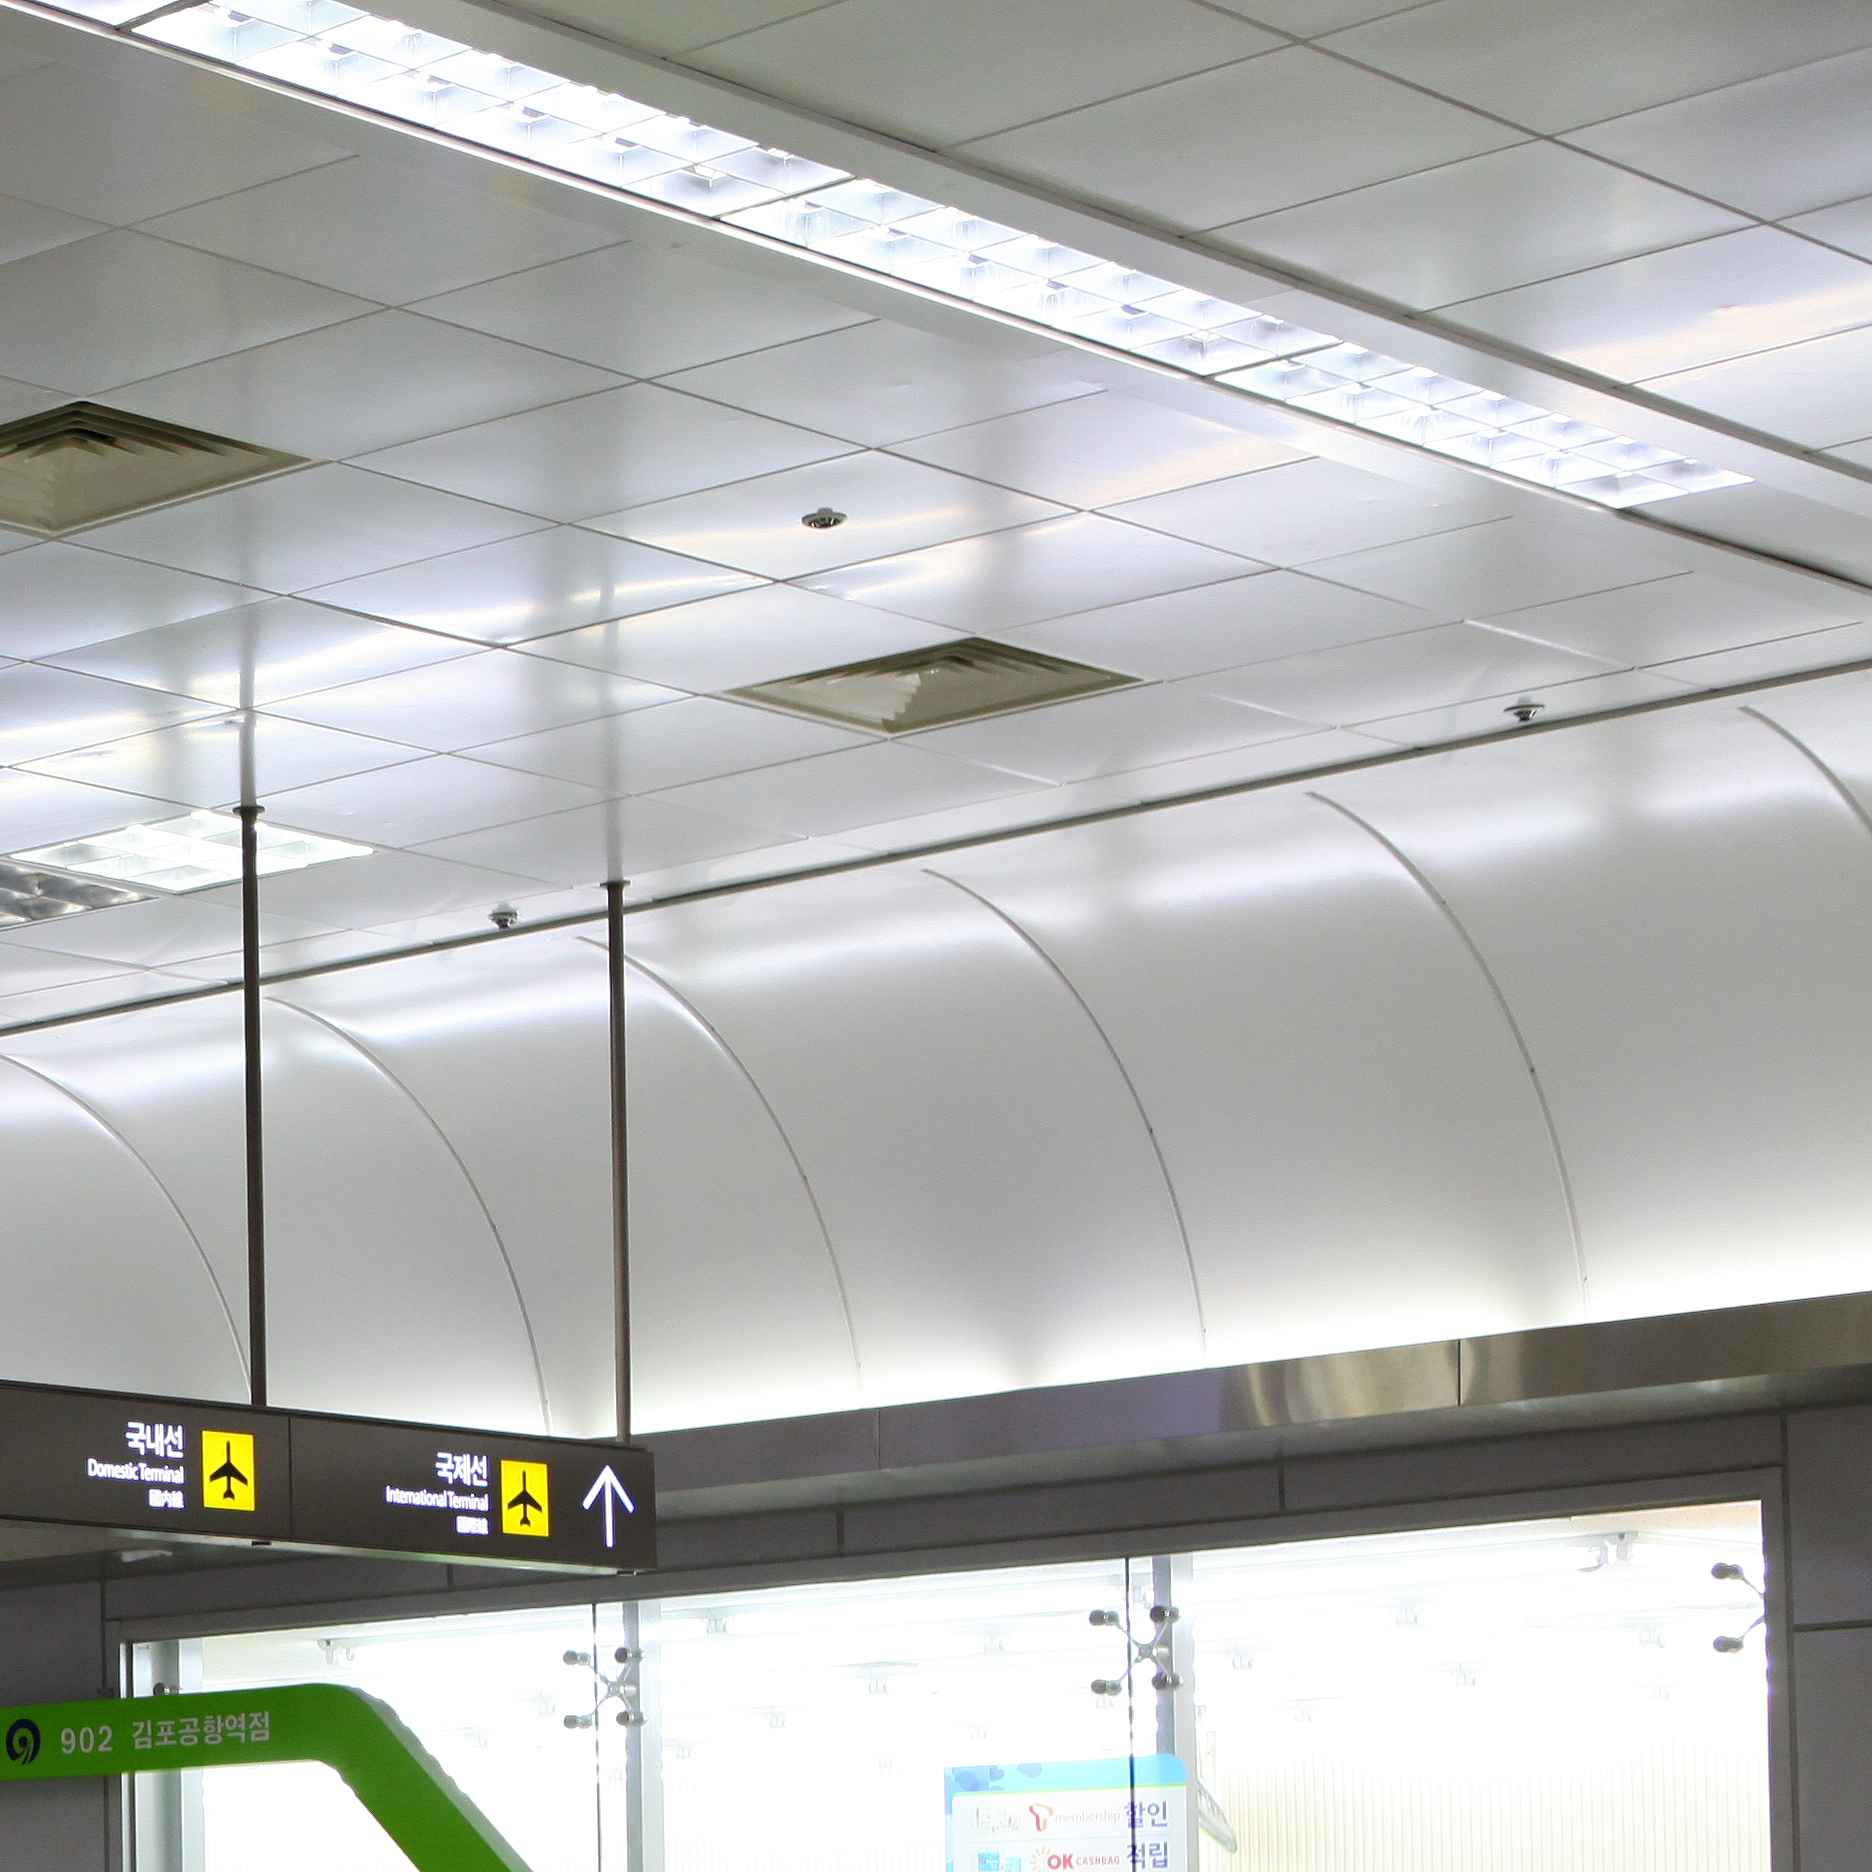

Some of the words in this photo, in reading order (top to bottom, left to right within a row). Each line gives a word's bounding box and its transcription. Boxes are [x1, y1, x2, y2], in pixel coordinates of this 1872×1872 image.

[125, 1421, 184, 1459] 국내선
[87, 1458, 139, 1482] Domestic
[140, 1462, 184, 1484] Terminal
[435, 1452, 488, 1487] 국제선
[386, 1485, 447, 1509] International
[448, 1490, 489, 1512] Terminal
[60, 1726, 113, 1754] 902
[132, 1712, 270, 1750] 김포공항역점
[1047, 1854, 1074, 1870] OK
[1076, 1855, 1120, 1866] CASHBAG
